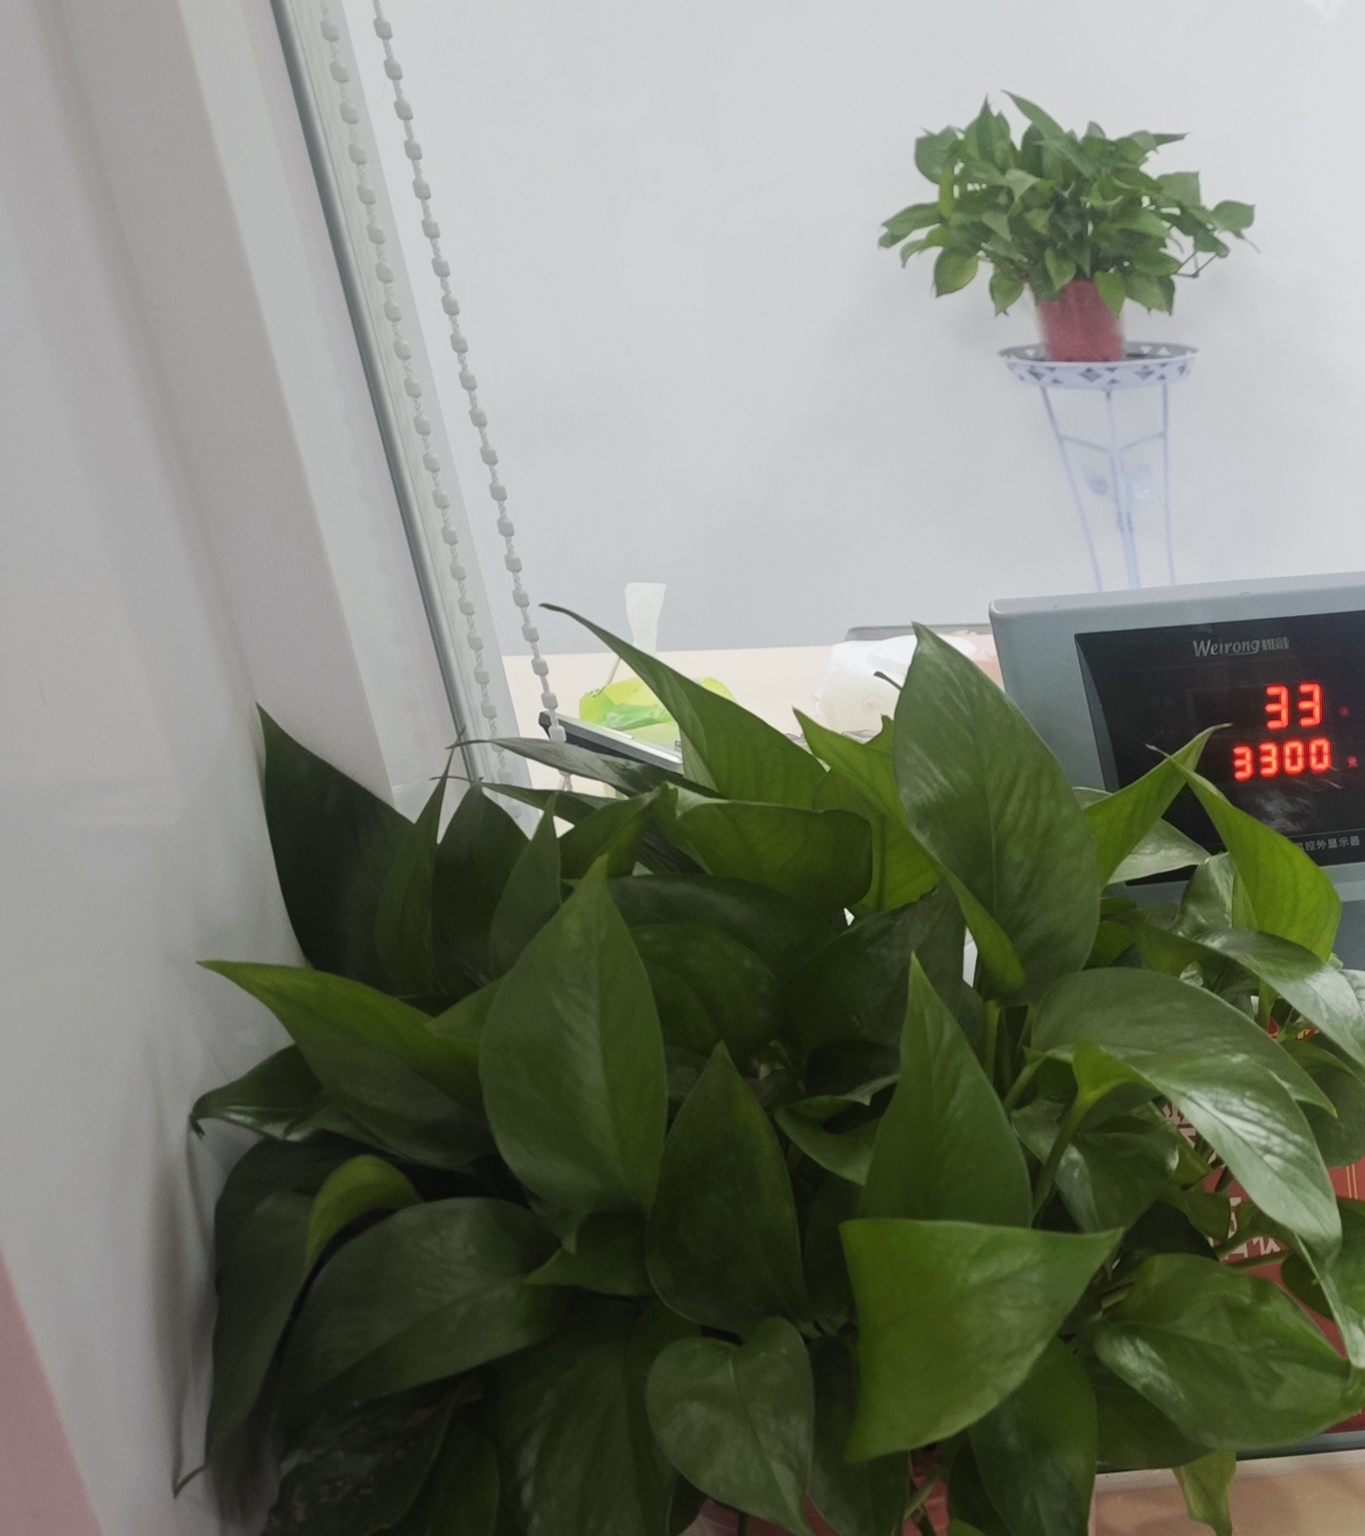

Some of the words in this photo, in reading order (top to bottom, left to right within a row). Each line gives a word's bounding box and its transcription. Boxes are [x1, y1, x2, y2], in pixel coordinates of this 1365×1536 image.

[1192, 638, 1260, 657] Weirong
[1264, 682, 1324, 730] 33
[1233, 736, 1332, 782] 3300
